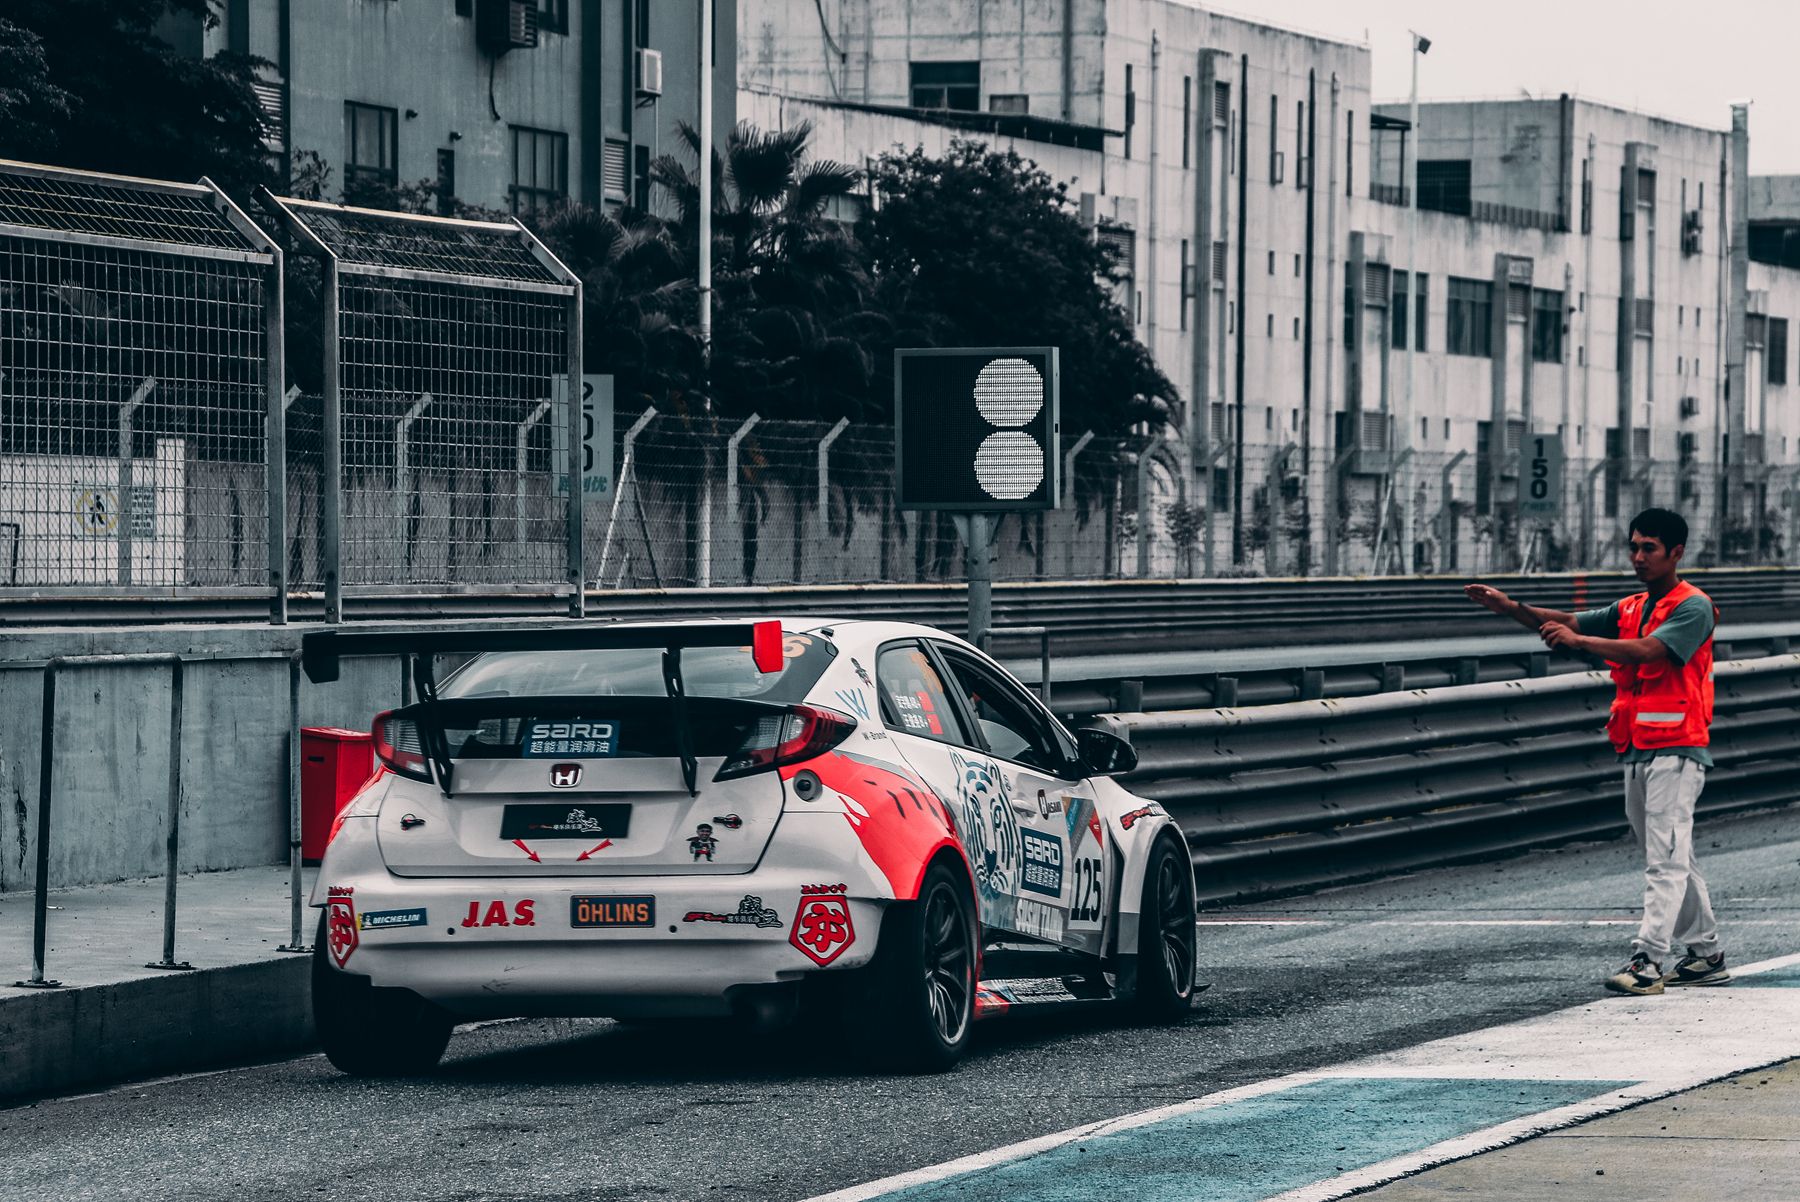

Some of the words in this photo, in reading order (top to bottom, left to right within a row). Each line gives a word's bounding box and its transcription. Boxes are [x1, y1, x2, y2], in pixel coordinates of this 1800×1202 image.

[1530, 438, 1548, 499] 150
[529, 740, 610, 753] 超能量润滑油
[1070, 857, 1102, 922] 125
[373, 913, 420, 924] MICHELIN
[461, 899, 536, 928] J.A.S.
[578, 898, 649, 924] ÖHLINS
